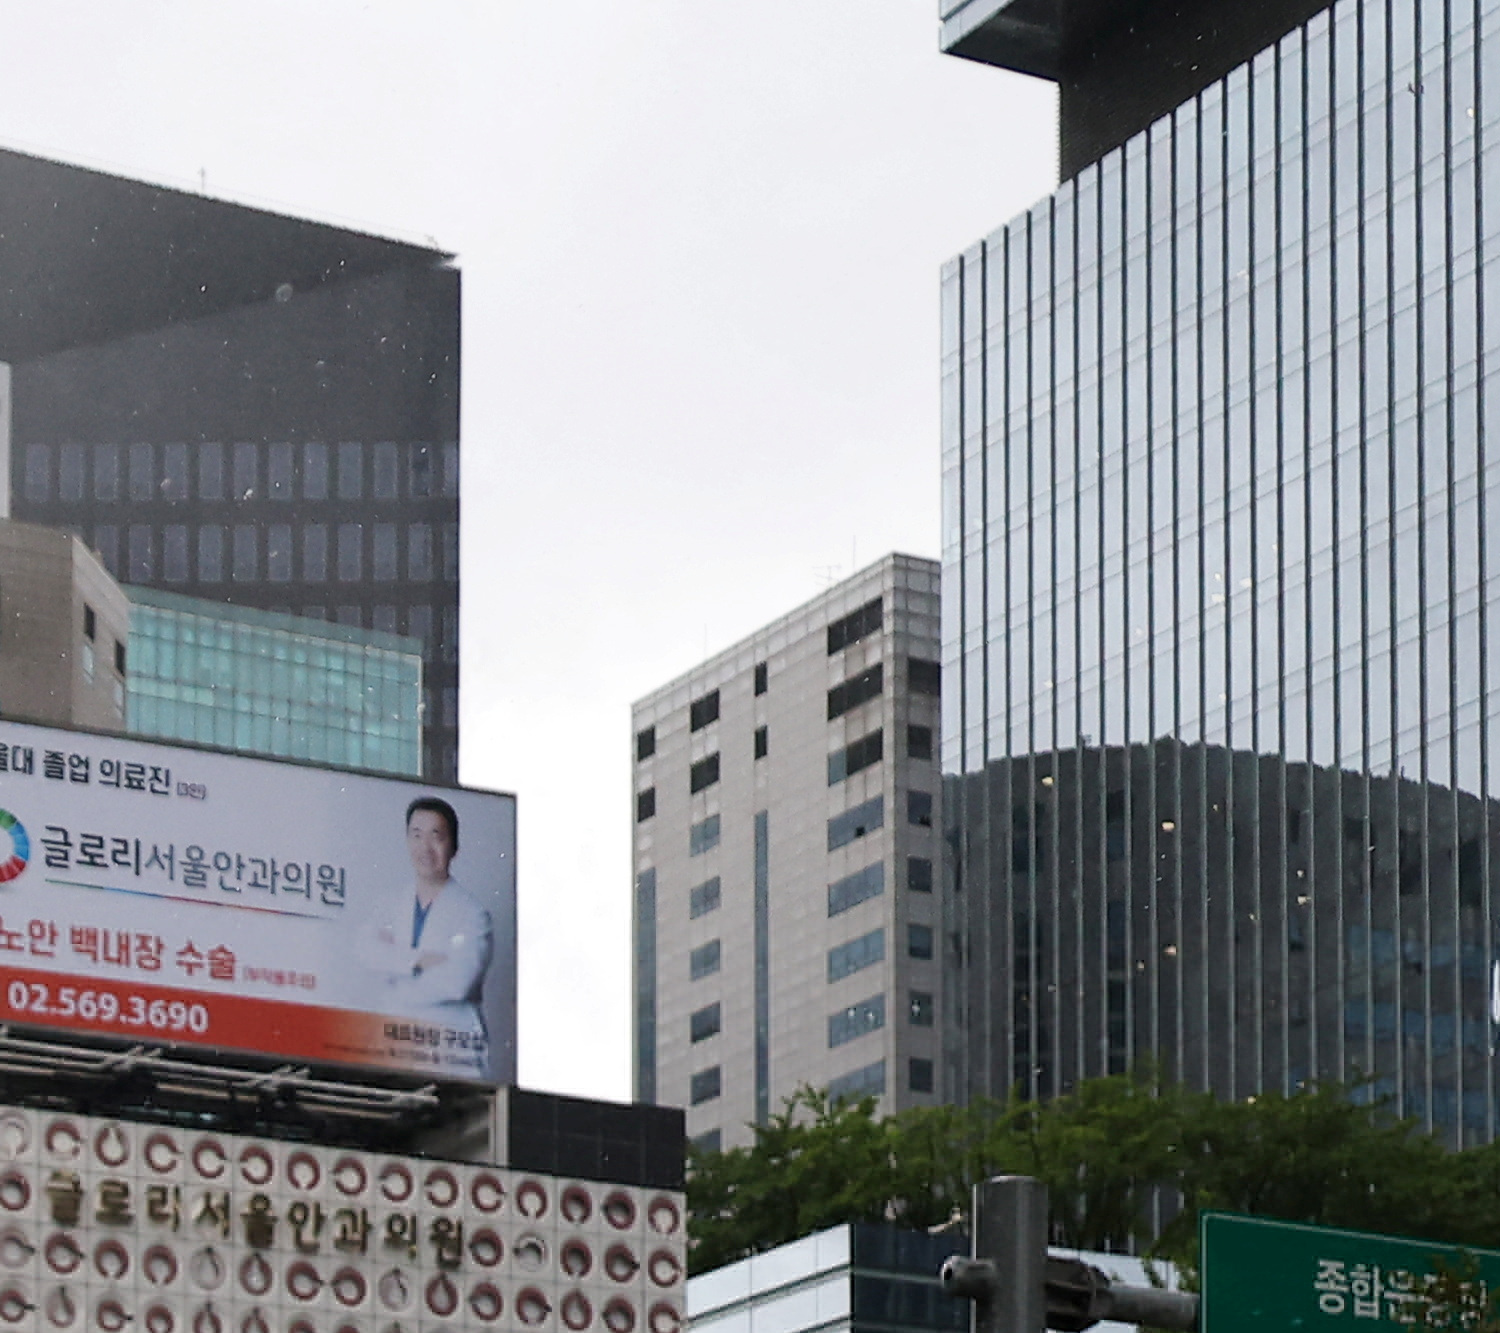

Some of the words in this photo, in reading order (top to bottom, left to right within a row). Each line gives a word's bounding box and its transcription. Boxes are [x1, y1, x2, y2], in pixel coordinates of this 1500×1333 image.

[43, 750, 90, 783] 졸업
[99, 758, 172, 796] 의료진
[40, 824, 347, 908] 글로리서울안과의원
[69, 923, 165, 972] 백내장
[176, 940, 236, 982] 수술
[7, 980, 209, 1034] 02.569.3690
[45, 1170, 464, 1271] 글로리서울안과의원
